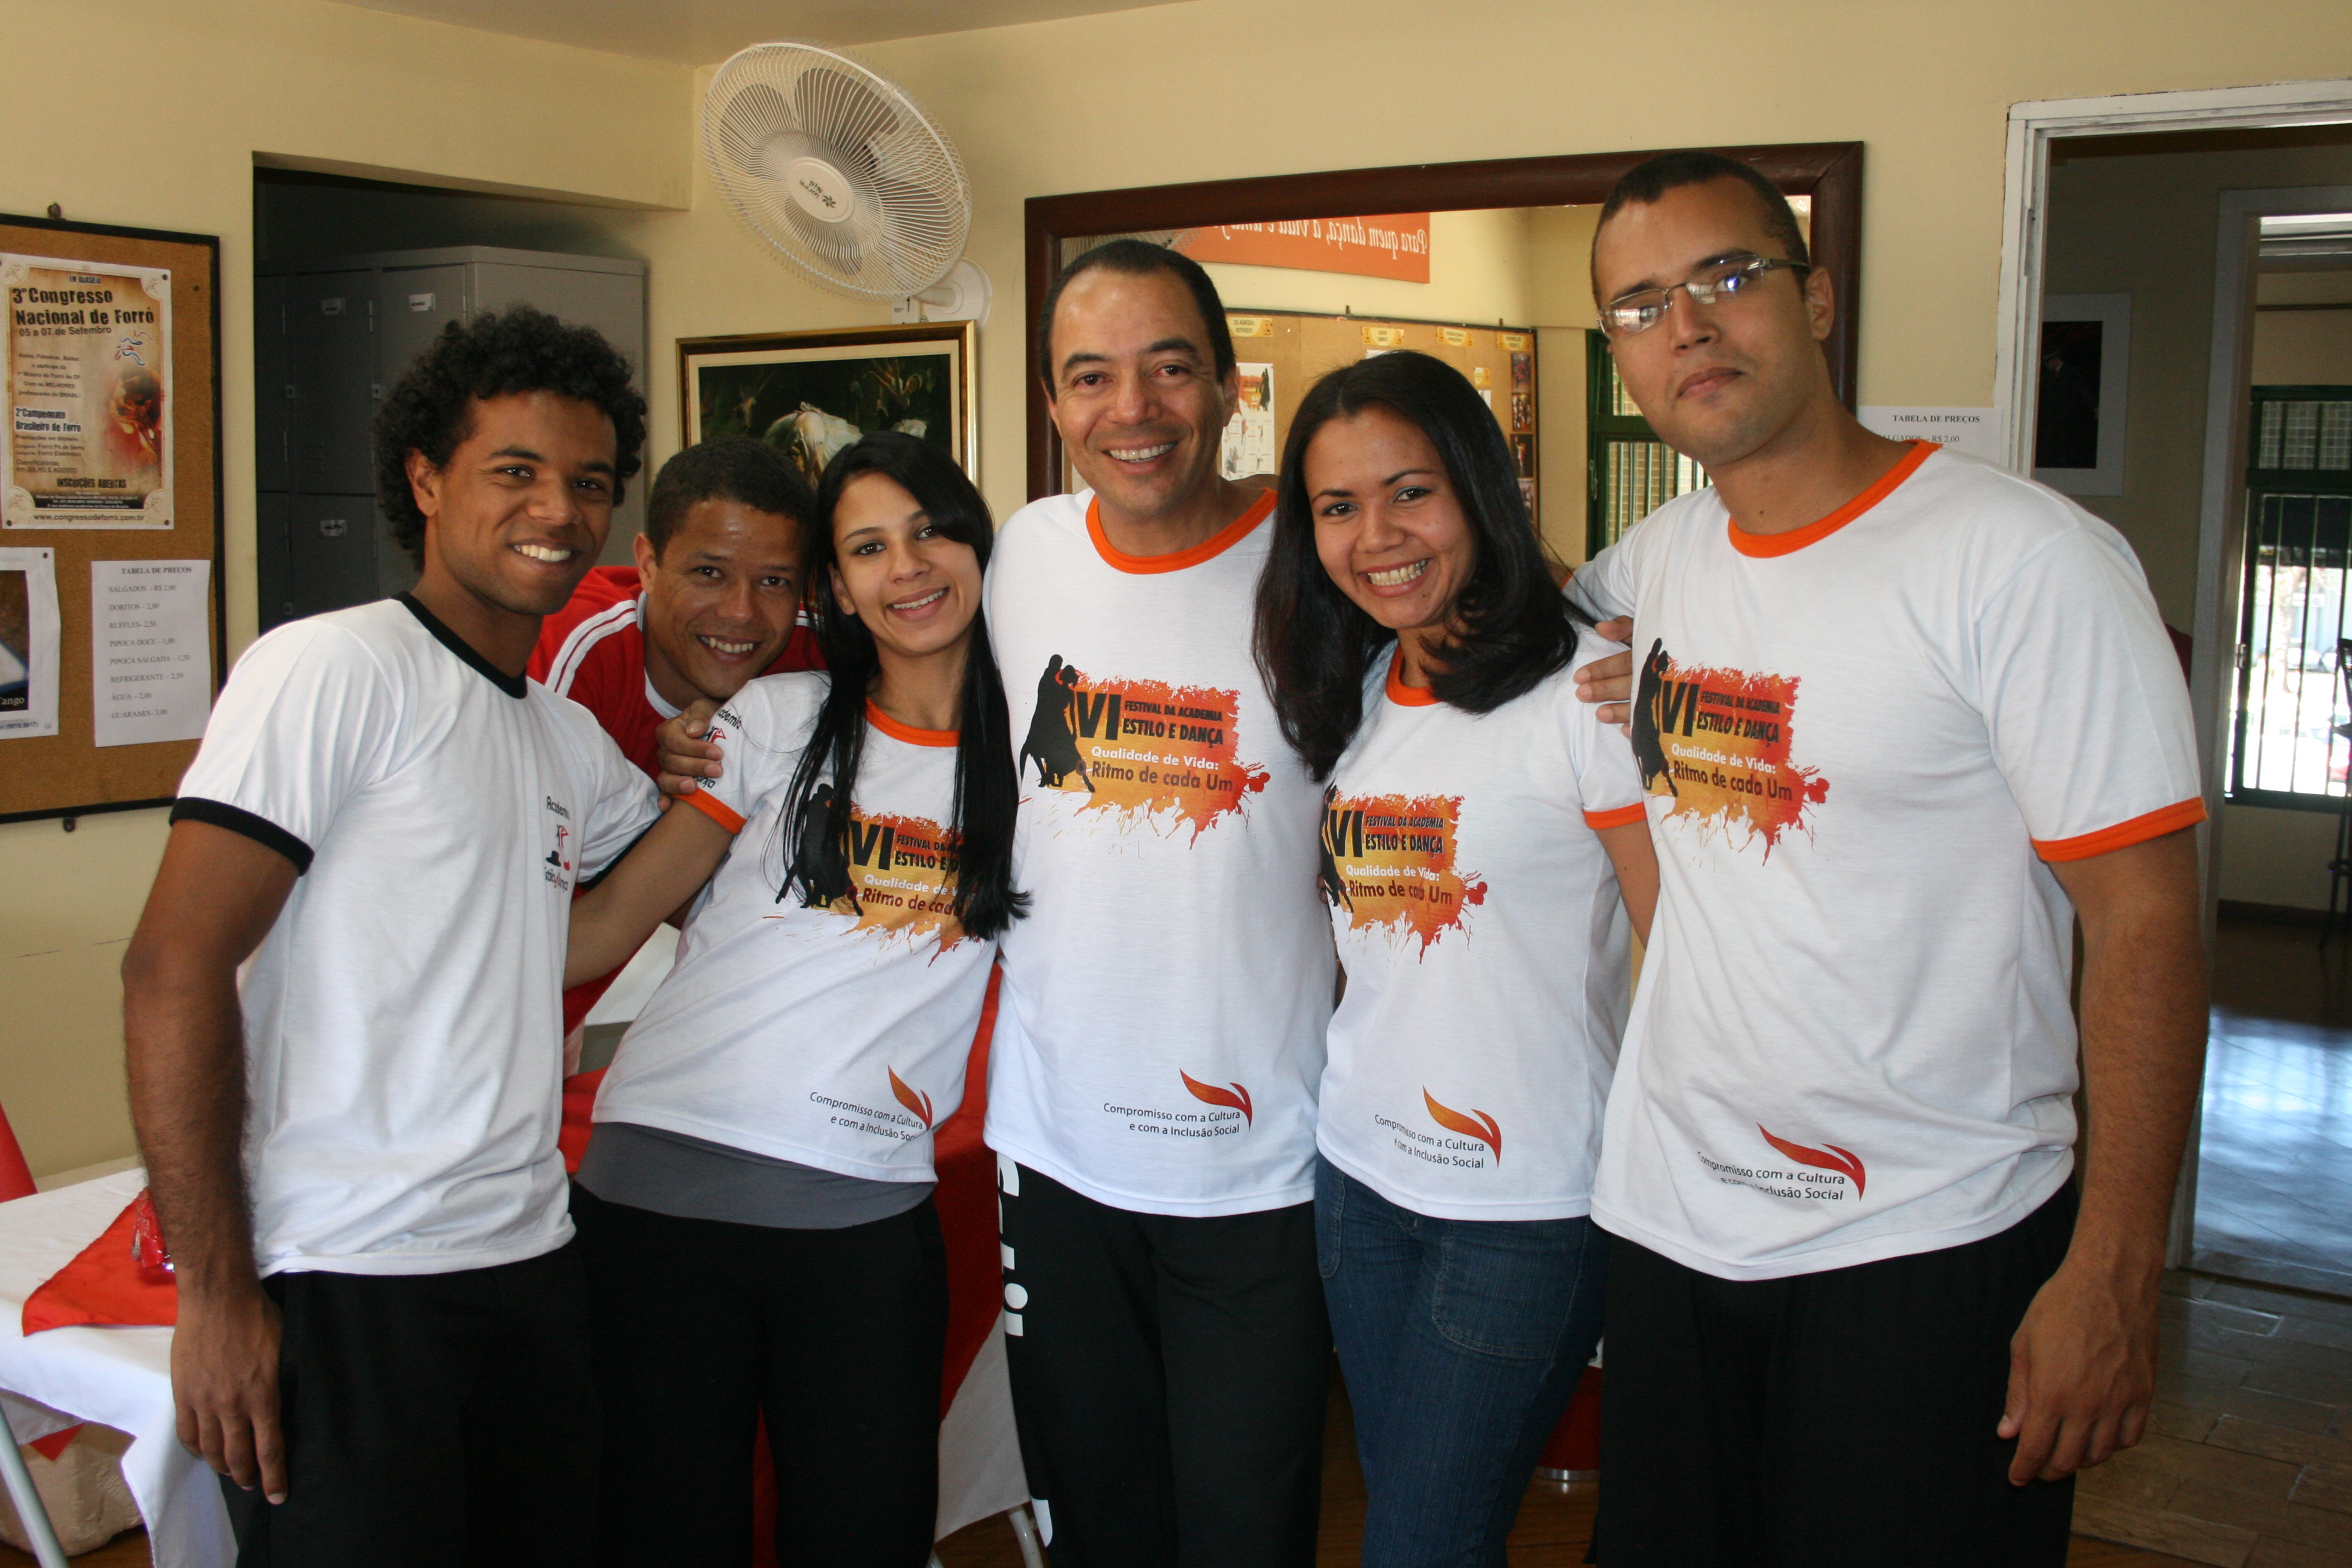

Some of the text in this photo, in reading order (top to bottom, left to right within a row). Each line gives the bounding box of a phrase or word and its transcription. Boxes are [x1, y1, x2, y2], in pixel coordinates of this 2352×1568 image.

[16, 307, 154, 325] Nacional de Forró
[16, 421, 81, 432] Brasileiro de Forró
[111, 674, 164, 683] REFRIGERANTE
[1125, 701, 1222, 722] FESTIVAL DA ACADEMIA
[1663, 681, 1700, 737] VI
[1700, 691, 1780, 715] FESTIVAL DA ACADEMIA
[1076, 691, 1122, 740] VI
[1123, 718, 1223, 748] ESTILO E DANÇA
[1697, 712, 1780, 747] ESTILO E DANÇA
[1091, 746, 1219, 771] Qualidade de Vida:
[1671, 743, 1776, 774] Qualidade de Vida:
[1092, 761, 1233, 792] Ritmo de cada Um
[1674, 760, 1792, 801] Ritmo de cada Um
[1330, 810, 1364, 857] VI
[1366, 816, 1444, 829] FESTIVAL DA ACADEMIA
[849, 820, 896, 871] VI
[897, 835, 930, 850] FESTIVAL
[1365, 834, 1444, 858] ESTILO E DANÇA
[895, 851, 935, 869] ESTILO
[940, 858, 946, 870] E
[1346, 864, 1440, 881] Qualidade de Vida:
[864, 874, 929, 892] Qualidade
[933, 884, 947, 895] de
[1350, 880, 1385, 897] Ritmo
[1389, 880, 1405, 897] de
[1429, 886, 1452, 904] Um
[863, 887, 903, 907] Ritmo
[909, 895, 926, 910] de
[810, 1092, 872, 1116] Compromisso
[874, 1111, 890, 1120] com
[897, 1114, 923, 1129] Cultura
[1103, 1103, 1172, 1120] Compromisso
[1175, 1113, 1197, 1122] com
[1209, 1111, 1240, 1122] Cultura
[839, 1118, 858, 1129] com
[866, 1123, 898, 1138] Inclusão
[1138, 1125, 1160, 1133] com
[1171, 1126, 1212, 1137] Inclusão
[1215, 1124, 1239, 1136] Social
[1375, 1114, 1416, 1139] Compromisso
[1417, 1134, 1434, 1146] com
[1445, 1138, 1485, 1151] Cultura
[1397, 1141, 1406, 1152] com
[1414, 1146, 1449, 1165] Inclusão
[1453, 1156, 1483, 1168] Social
[1697, 1151, 1753, 1177] Compromisso
[1756, 1169, 1782, 1179] com
[1797, 1172, 1844, 1184] Cultura
[1805, 1187, 1844, 1200] Social
